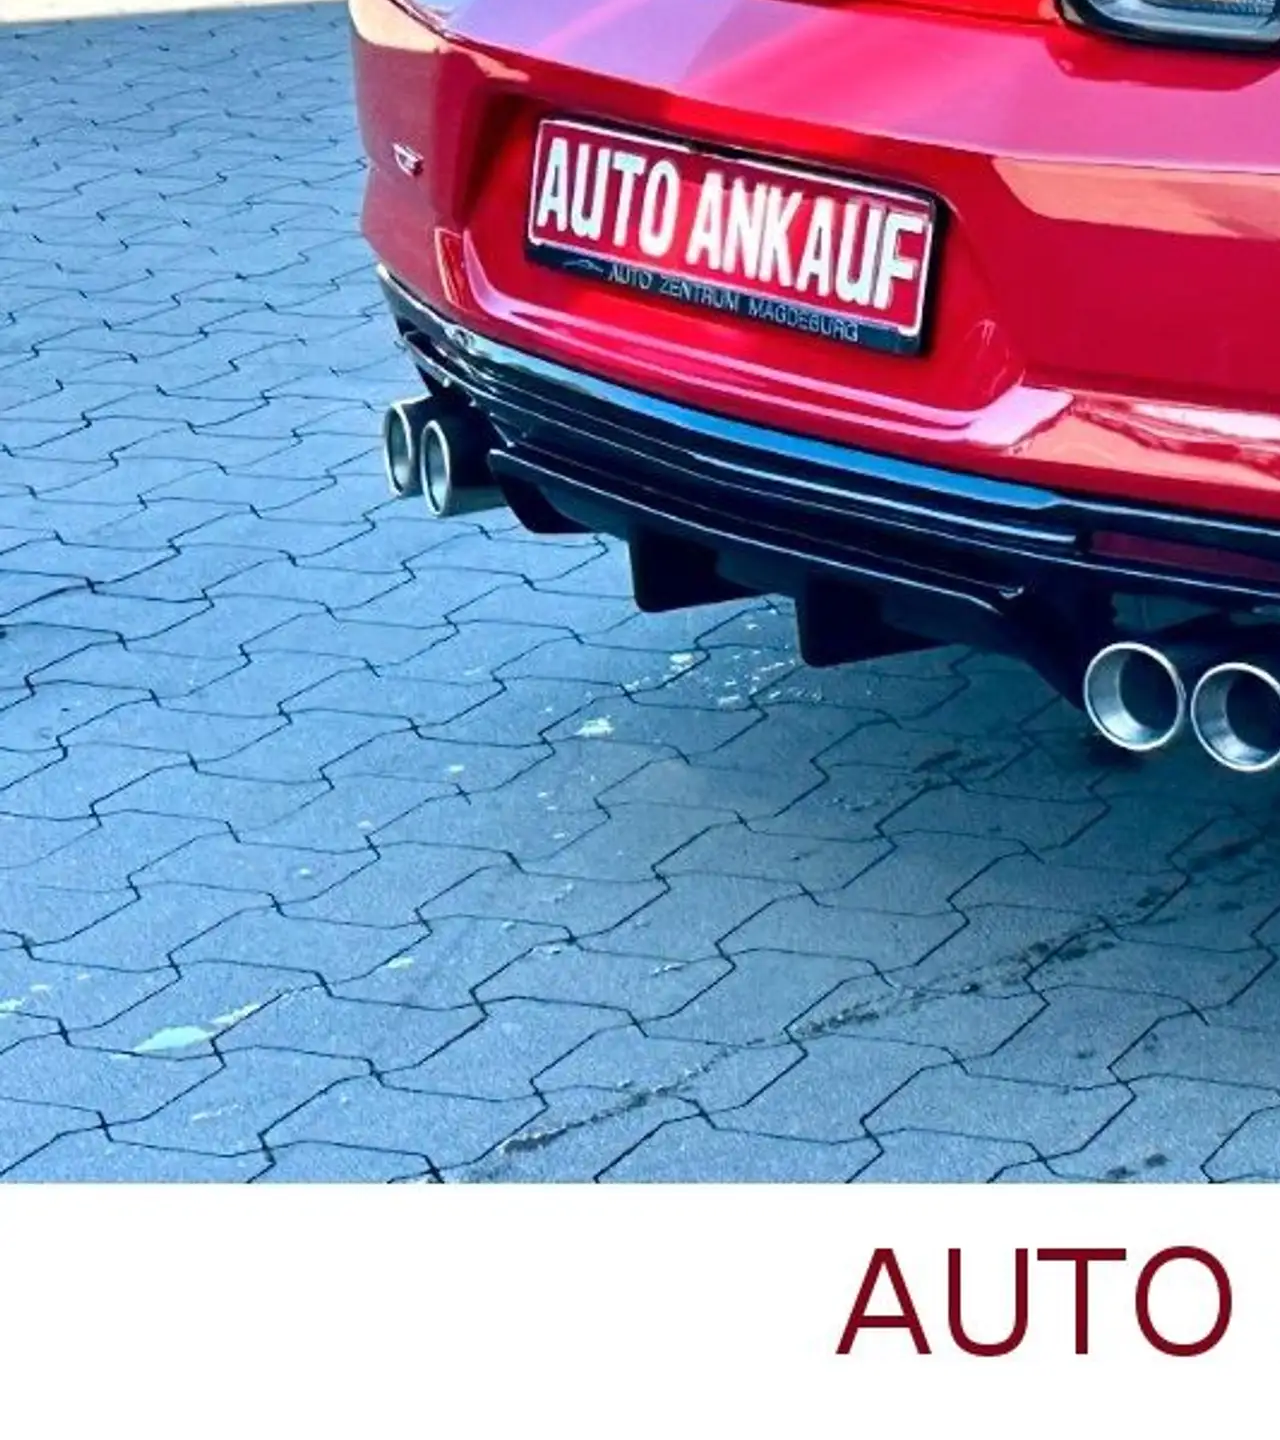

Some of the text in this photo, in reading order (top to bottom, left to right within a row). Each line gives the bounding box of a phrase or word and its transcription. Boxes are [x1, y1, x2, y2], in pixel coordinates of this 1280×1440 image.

[536, 136, 927, 310] AUTO ANKAUF
[608, 262, 858, 342] AUTO ZENTRUM MAGDEBURG
